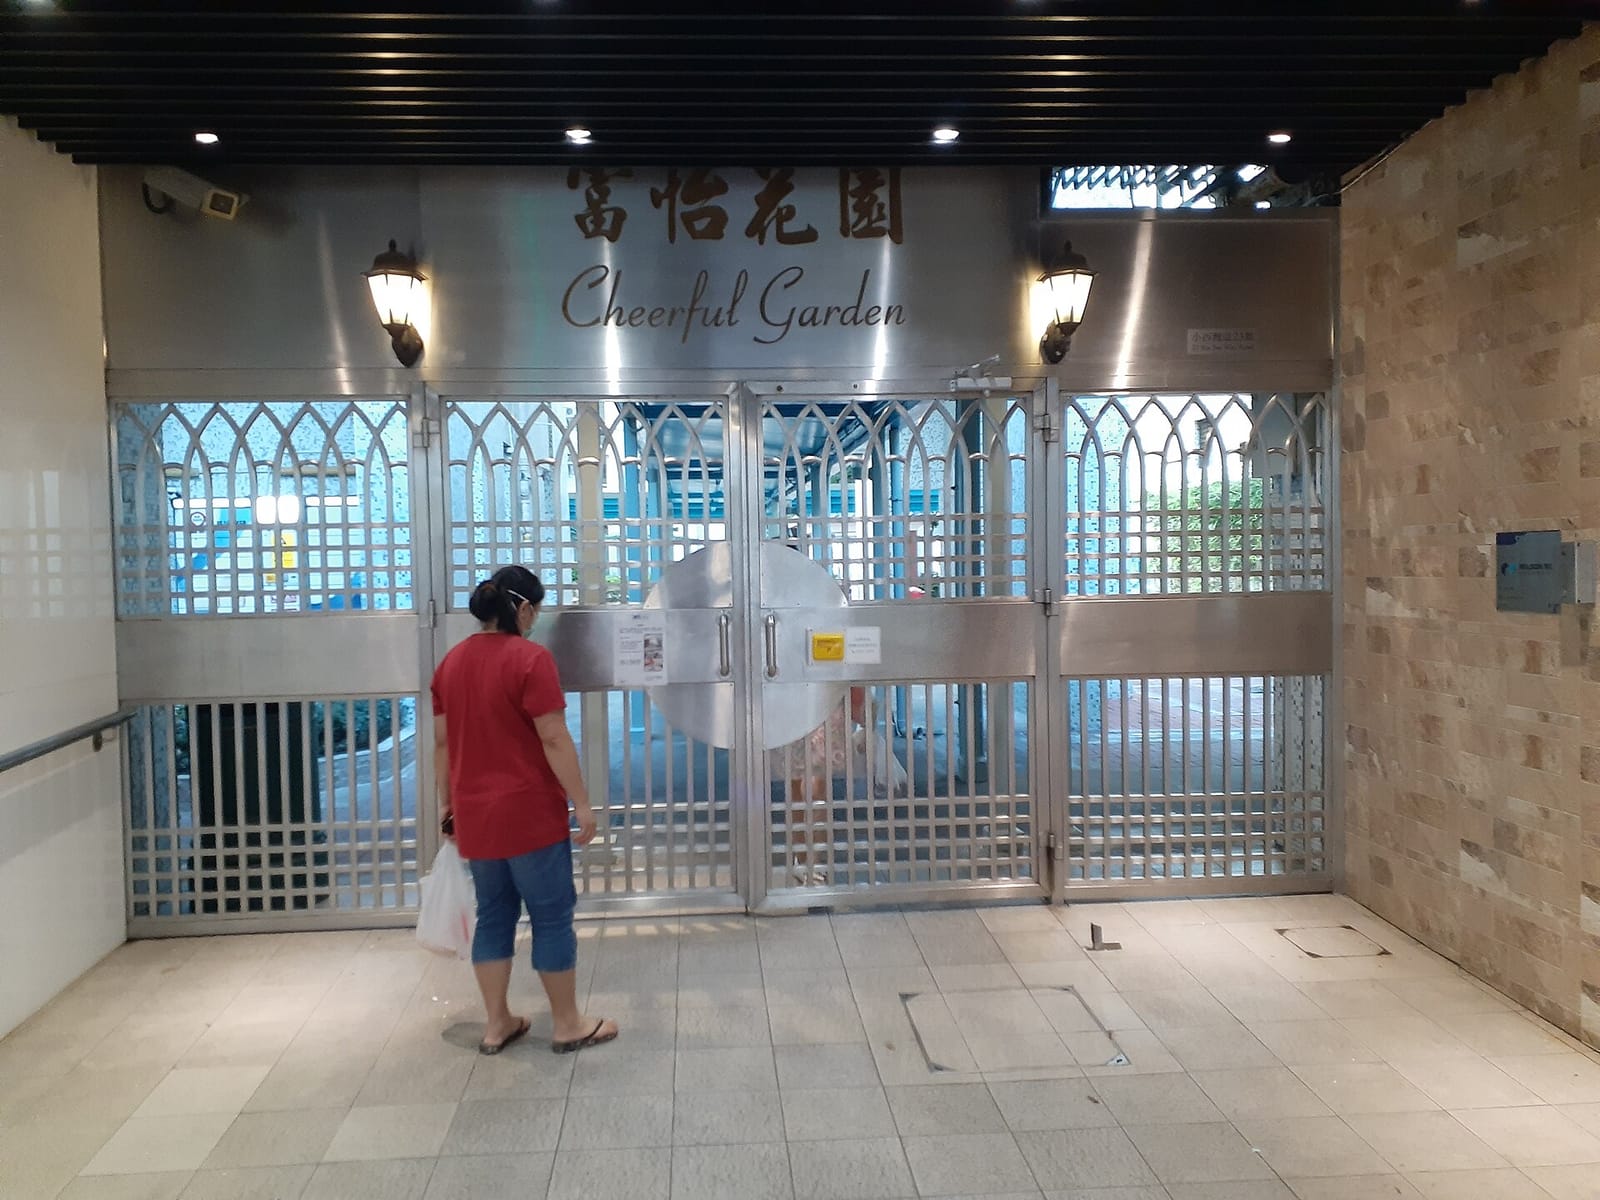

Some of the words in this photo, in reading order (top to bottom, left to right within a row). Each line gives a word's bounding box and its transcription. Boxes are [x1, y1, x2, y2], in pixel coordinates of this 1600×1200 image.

[566, 166, 904, 245] 富怡花園
[562, 265, 748, 344] Cheerful
[753, 266, 905, 344] Garden
